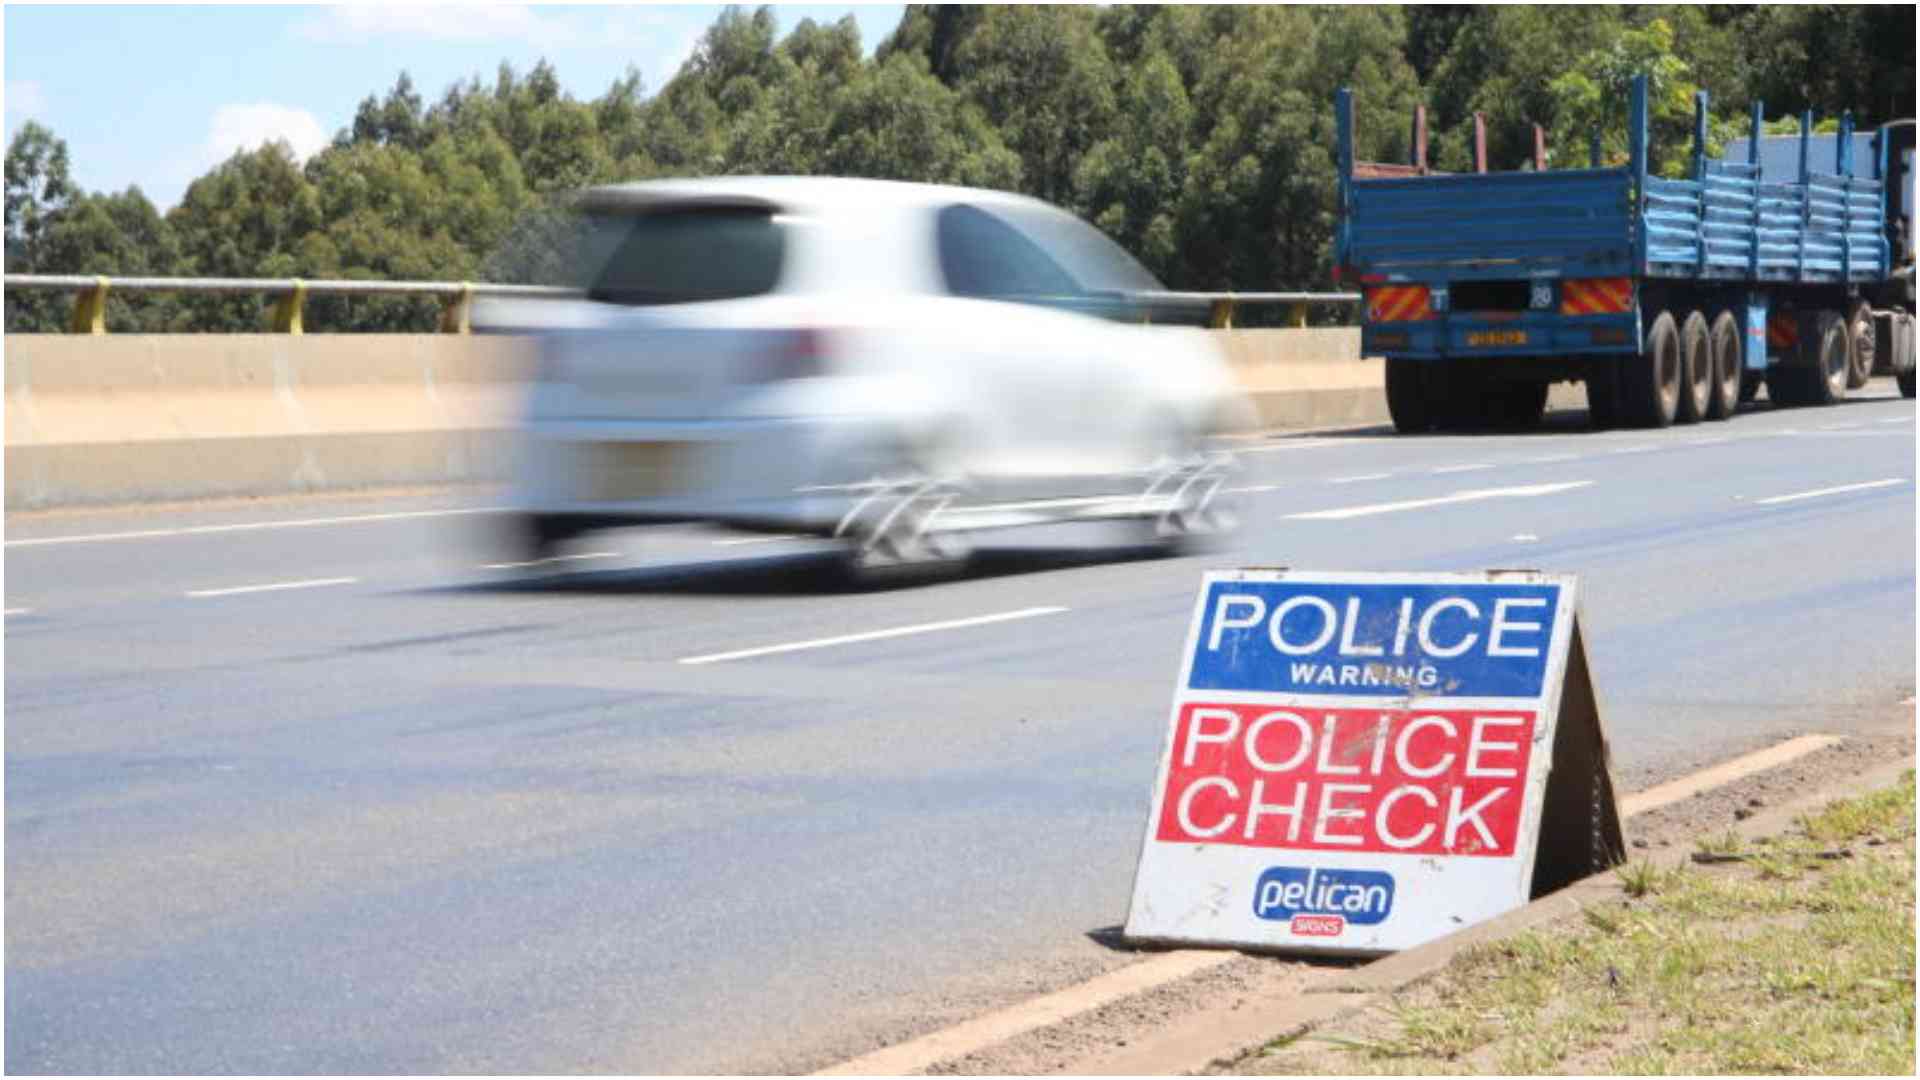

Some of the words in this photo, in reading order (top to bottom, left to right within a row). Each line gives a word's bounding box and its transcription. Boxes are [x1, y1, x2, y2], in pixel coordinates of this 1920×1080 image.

[1208, 595, 1547, 658] POLICE
[1291, 663, 1438, 686] WARNING
[1183, 708, 1525, 778] POLICE
[1177, 775, 1511, 850] CHECK
[1258, 867, 1387, 915] pelican
